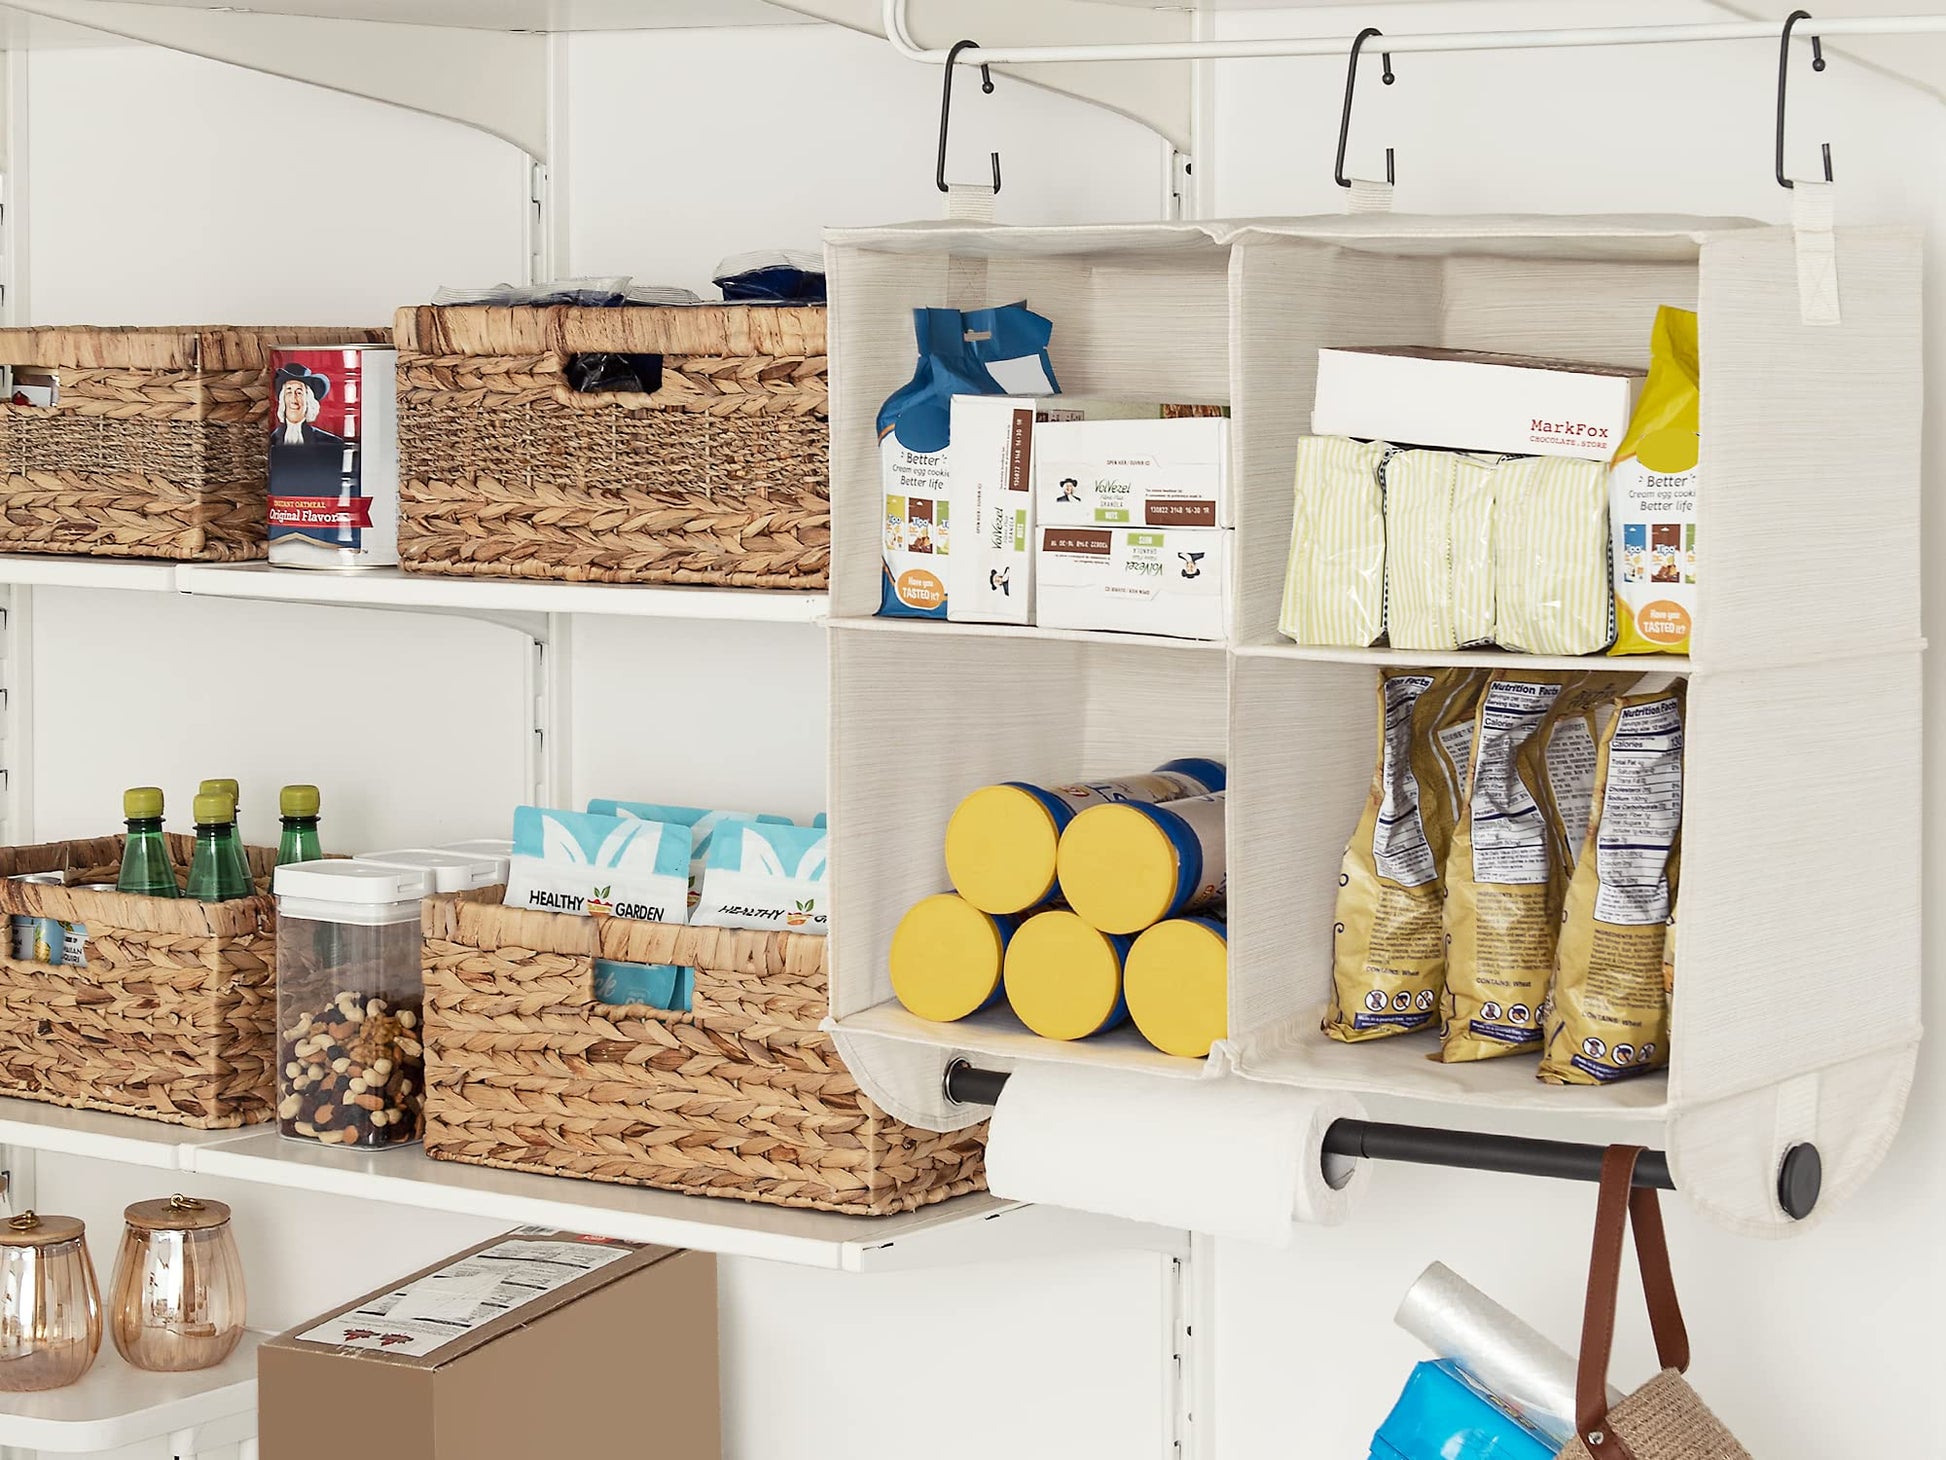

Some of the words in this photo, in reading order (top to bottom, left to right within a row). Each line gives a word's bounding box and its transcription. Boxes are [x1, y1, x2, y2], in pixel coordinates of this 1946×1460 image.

[1530, 419, 1609, 438] MarkFox
[906, 452, 941, 466] Better
[892, 463, 912, 473] Cream
[913, 468, 927, 477] egg
[900, 475, 927, 487] Better
[928, 478, 944, 490] life
[1647, 475, 1688, 487] Better
[1628, 490, 1655, 498] Cream
[1657, 491, 1673, 500] egg
[1640, 501, 1673, 511] Better
[1675, 500, 1693, 512] life
[269, 508, 300, 523] Original
[902, 587, 930, 600] TASTED
[1642, 622, 1675, 634] TASTED
[1490, 682, 1536, 695] Nutrition
[1538, 686, 1559, 695] Facts
[1622, 705, 1660, 719] Nutrition
[1660, 702, 1678, 711] Facts
[1611, 740, 1643, 748] Calories
[529, 889, 585, 912] HEALTHY
[615, 901, 665, 922] GARDEN
[718, 904, 788, 921] HEALTHY
